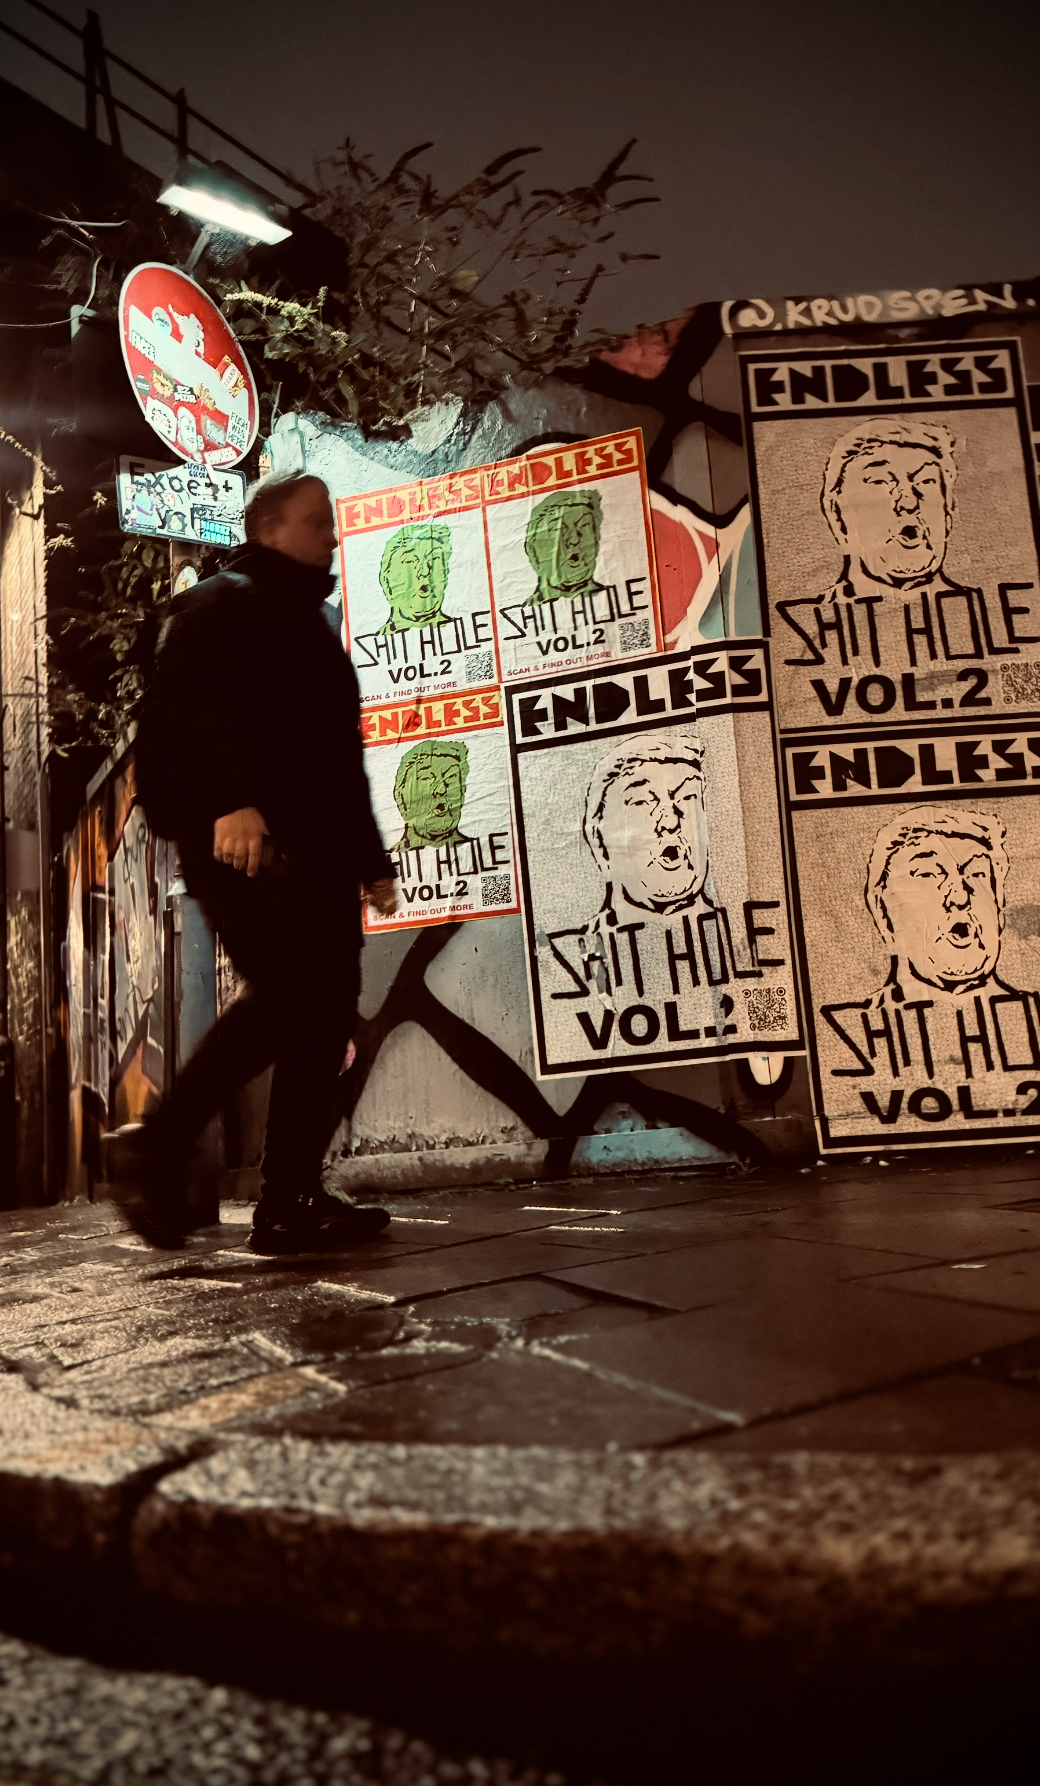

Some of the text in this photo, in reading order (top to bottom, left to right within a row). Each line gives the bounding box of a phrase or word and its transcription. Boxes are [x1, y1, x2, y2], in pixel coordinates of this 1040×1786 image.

[754, 354, 1008, 407] ENDLESS
[486, 440, 636, 493] ENDLESS
[344, 475, 481, 525] ENDLESS
[499, 577, 649, 641] SHIT HOLE
[776, 582, 1040, 668] SHIT HOLE
[354, 611, 492, 669] SHIT HOLE
[507, 667, 531, 676] SCAN
[542, 659, 563, 669] FIND
[565, 656, 584, 666] OUT
[586, 651, 612, 661] MORE
[536, 628, 606, 656] VOL.2
[388, 659, 452, 684] VOL.2
[393, 689, 413, 698] FIND
[413, 685, 431, 694] OUT
[433, 681, 458, 691] MORE
[520, 654, 763, 738] ENDLESS
[810, 667, 992, 717] VOL.2
[361, 696, 499, 741] ENDLESS
[384, 832, 510, 883] HIT HOLE
[402, 880, 469, 903] VOL.2
[407, 909, 427, 917] FIND
[430, 907, 447, 915] OUT
[449, 903, 474, 912] MORE
[548, 901, 785, 999] SHIT HOLE
[821, 1000, 934, 1079] SHIT
